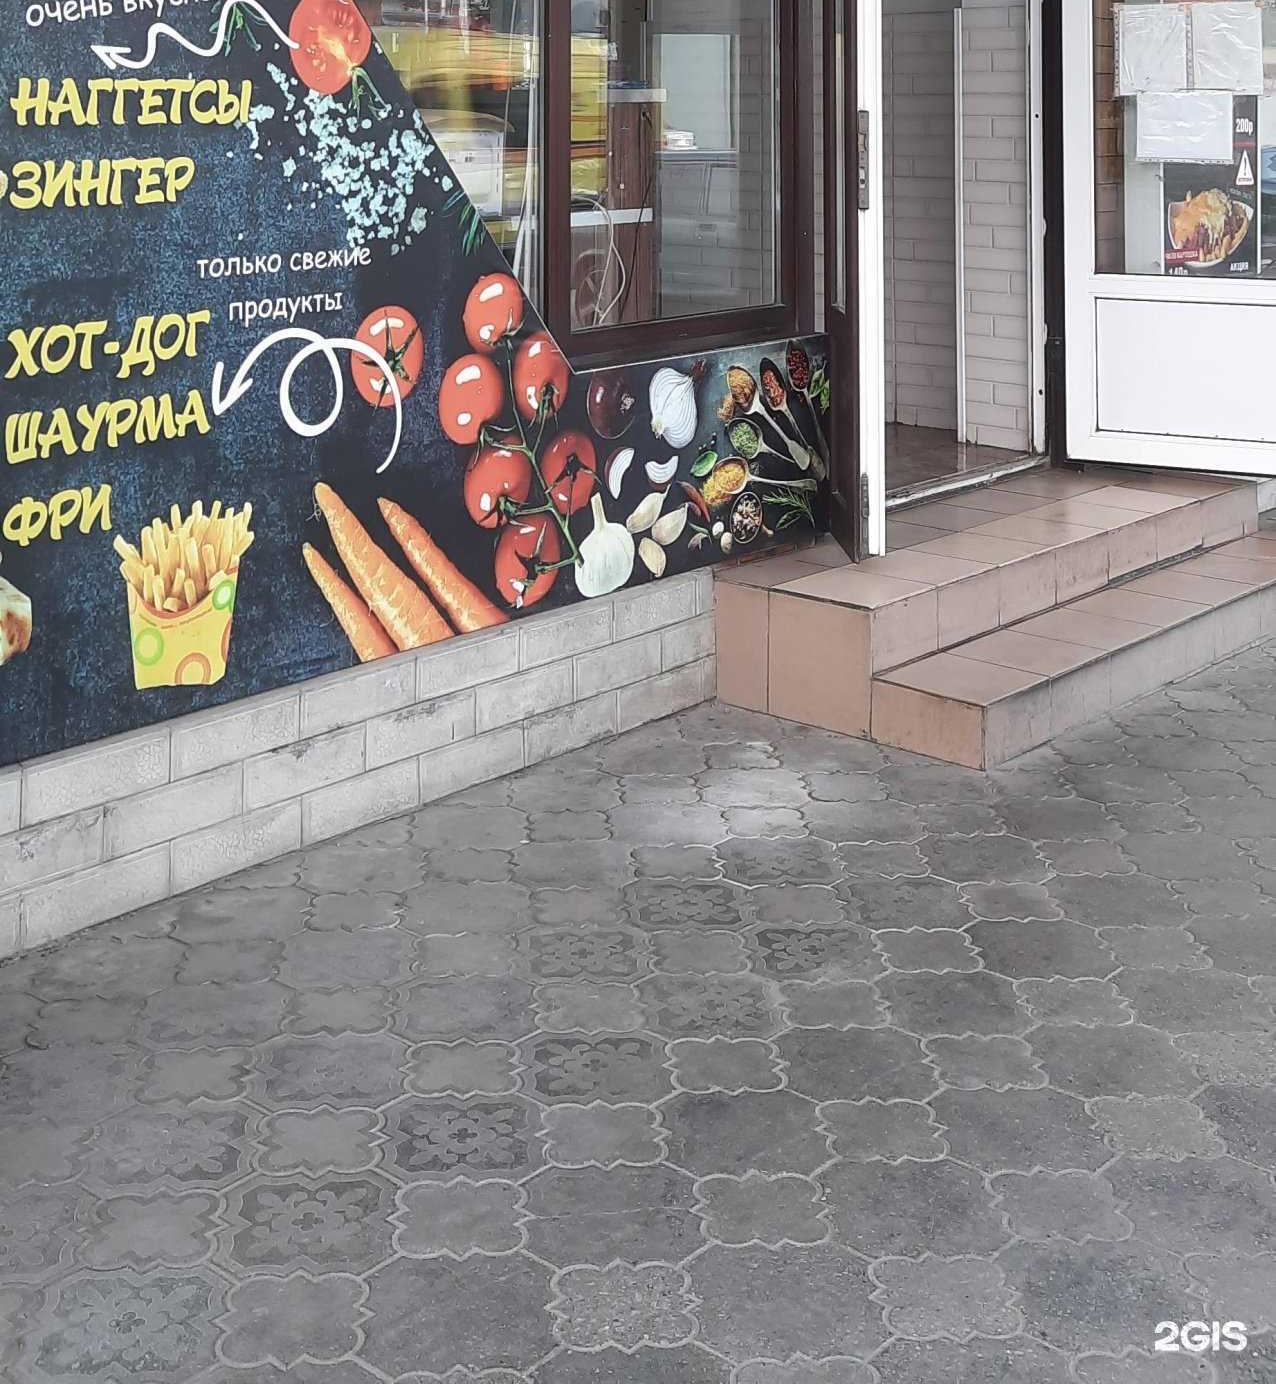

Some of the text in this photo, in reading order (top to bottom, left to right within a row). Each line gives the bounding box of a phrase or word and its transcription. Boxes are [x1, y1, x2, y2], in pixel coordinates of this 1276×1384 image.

[10, 77, 253, 127] НАГГЕТСЫ
[9, 157, 195, 210] ЗИНГЕР
[196, 245, 372, 279] только свежие
[228, 291, 343, 325] продукты
[4, 310, 211, 379] ХОТ-ДОГ
[3, 390, 211, 466] ШАУРМА
[2, 483, 112, 547] ФРИ
